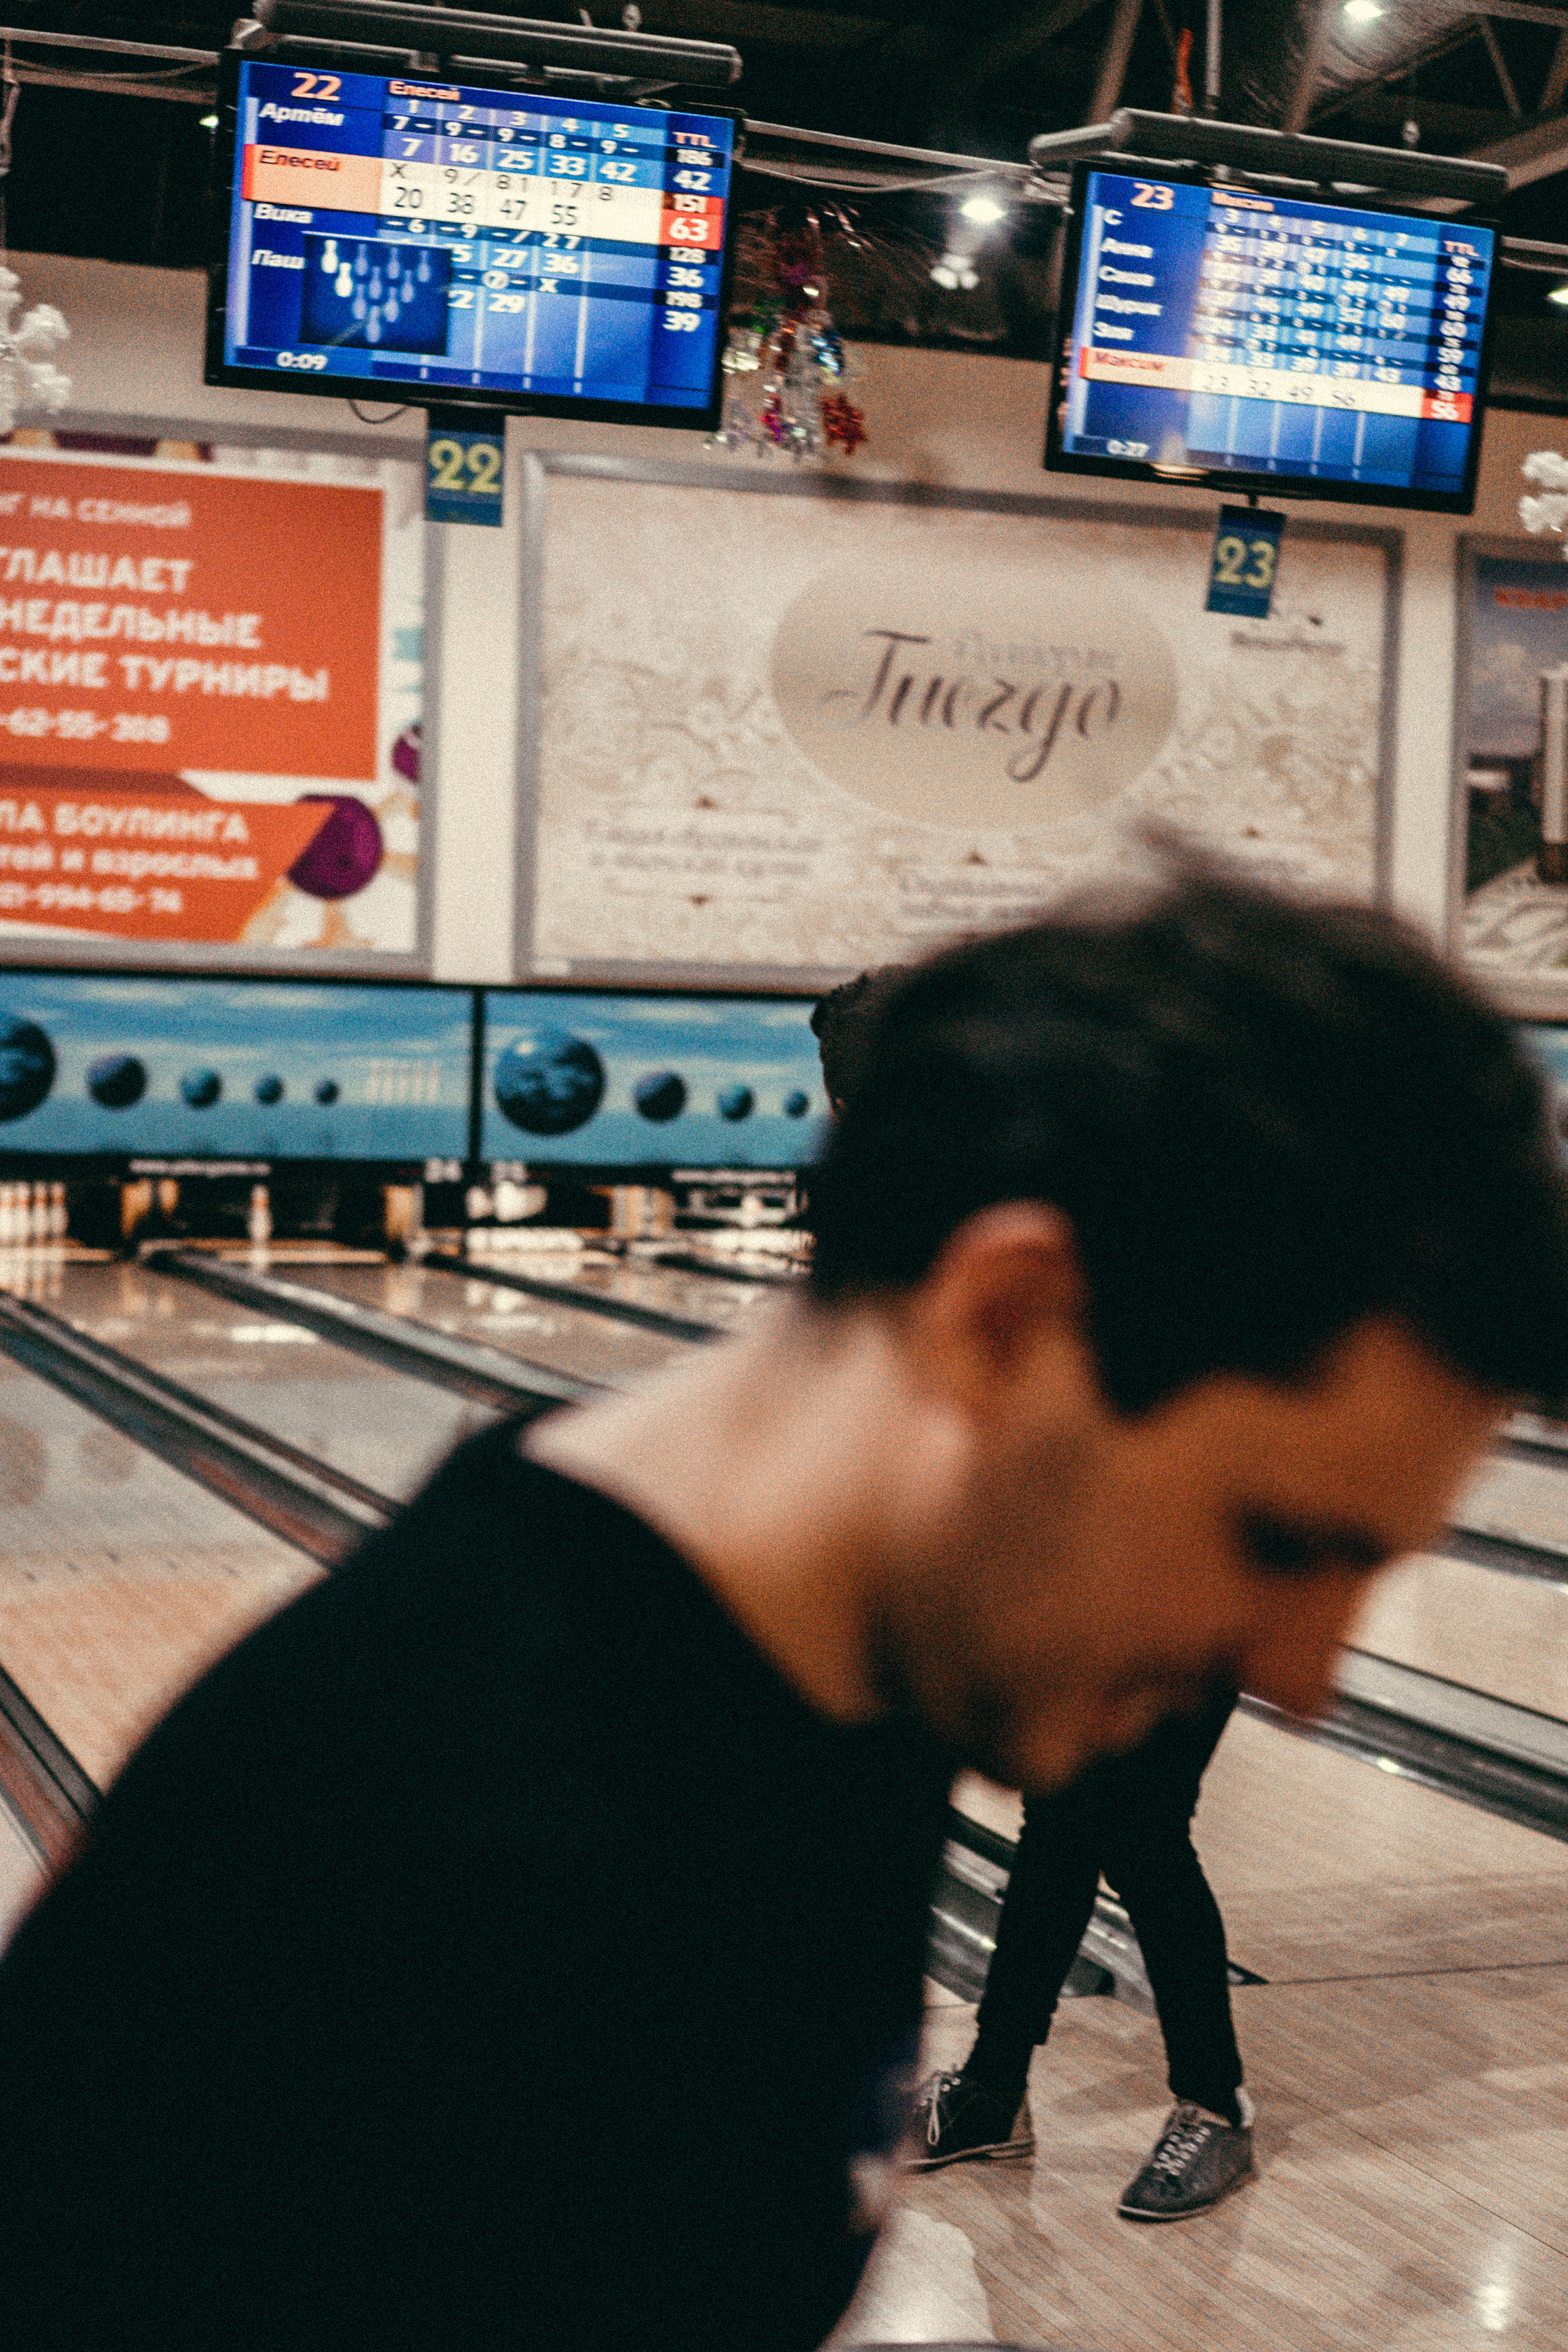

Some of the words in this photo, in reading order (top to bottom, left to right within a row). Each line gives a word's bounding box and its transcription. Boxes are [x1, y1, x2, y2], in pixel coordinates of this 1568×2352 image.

[291, 72, 342, 101] 22
[258, 102, 344, 126] Артём
[409, 99, 420, 113] 1
[458, 105, 475, 121] 2
[510, 111, 527, 126] 3
[562, 118, 579, 132] 4
[613, 124, 630, 138] 5
[401, 137, 423, 157] 7
[449, 143, 479, 164] 16
[497, 149, 535, 170] 25
[549, 154, 586, 176] 33
[599, 161, 638, 182] 42
[390, 162, 407, 179] X
[598, 186, 613, 202] 8
[673, 170, 712, 192] 42
[394, 186, 423, 209] 20
[447, 192, 474, 215] 38
[500, 198, 527, 221] 47
[551, 203, 578, 226] 55
[1131, 183, 1175, 210] 23
[254, 203, 312, 224] Вика
[1223, 208, 1240, 224] 3
[669, 217, 708, 241] 63
[450, 243, 473, 263] 5
[543, 252, 579, 274] 36
[538, 277, 560, 293] X
[666, 266, 704, 288] 36
[448, 290, 475, 309] 2
[488, 293, 526, 314] 29
[663, 309, 701, 333] 39
[277, 351, 328, 370] 0:09
[429, 439, 503, 494] 22
[1214, 535, 1277, 589] 23
[119, 655, 328, 702] ТУРНИРЫ
[55, 804, 249, 843] БОУЛИНГА
